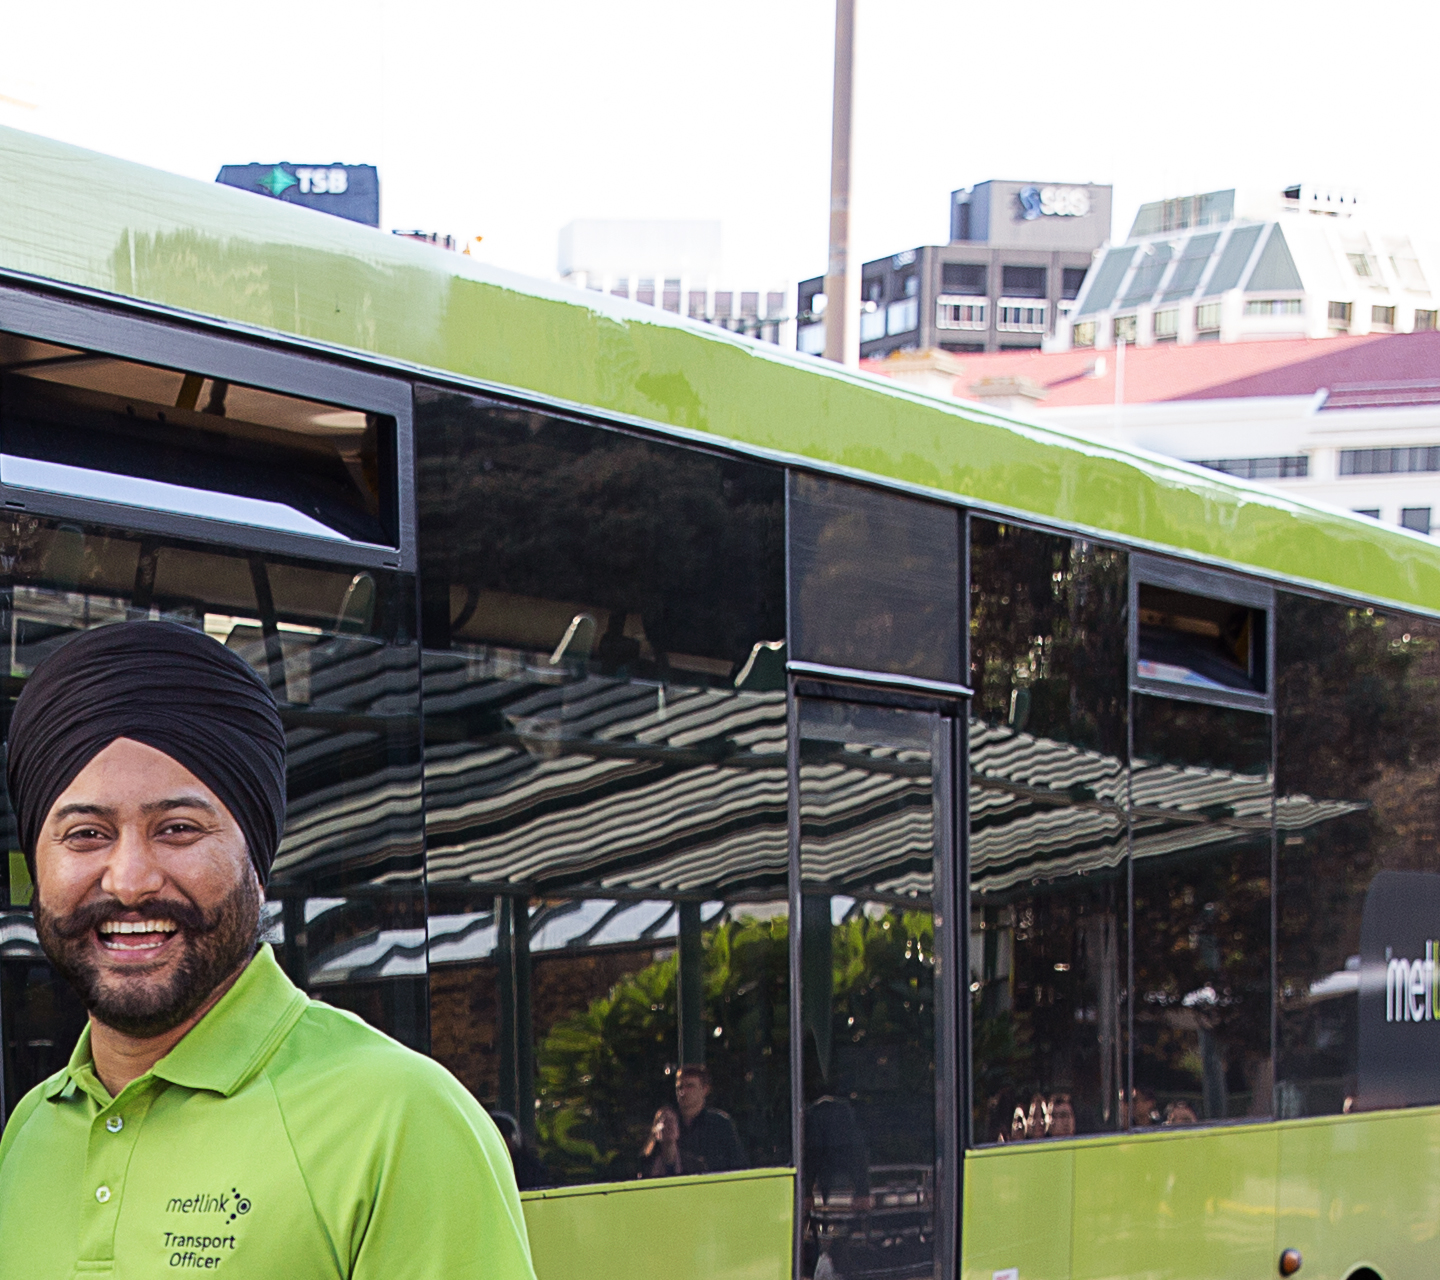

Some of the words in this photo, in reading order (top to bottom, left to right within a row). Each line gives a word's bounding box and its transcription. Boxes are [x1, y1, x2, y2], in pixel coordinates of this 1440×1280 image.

[295, 168, 348, 194] TSB
[165, 1193, 230, 1214] metlink
[163, 1232, 236, 1252] Transport
[169, 1252, 222, 1269] Officer
